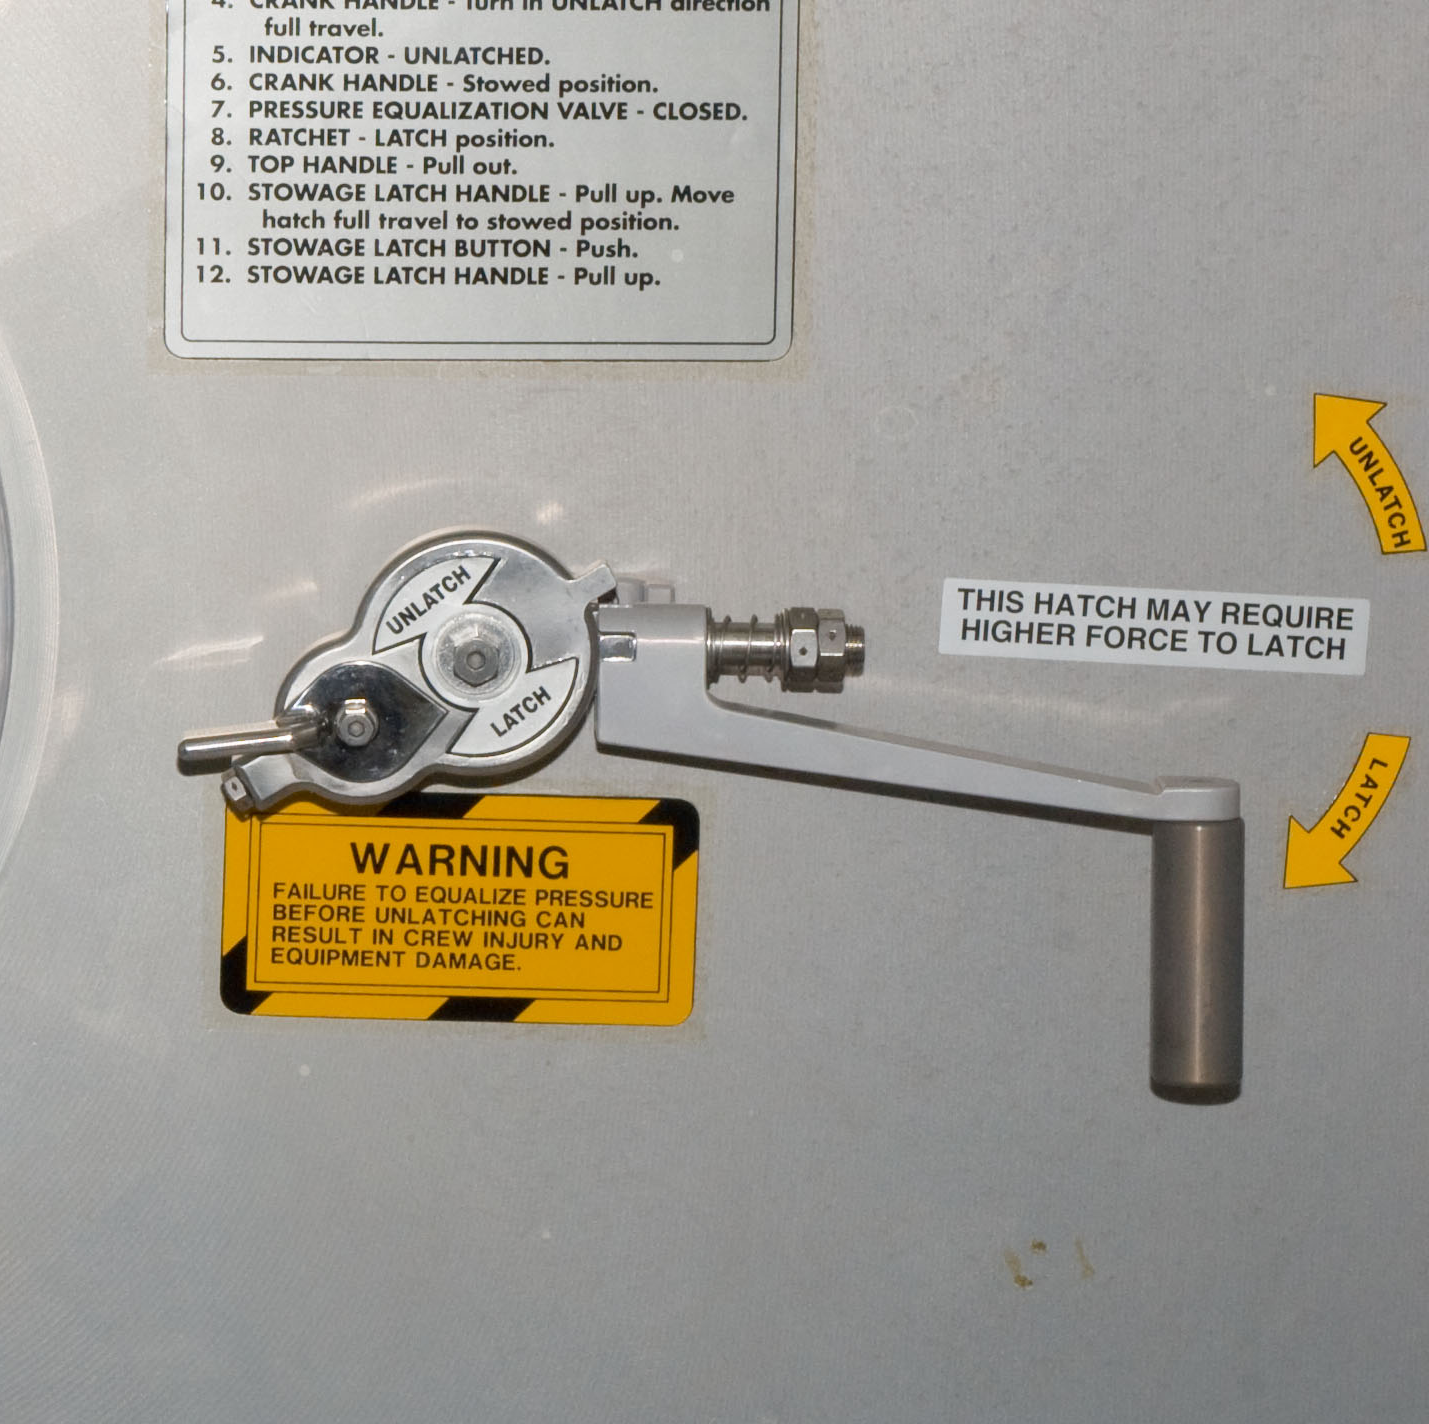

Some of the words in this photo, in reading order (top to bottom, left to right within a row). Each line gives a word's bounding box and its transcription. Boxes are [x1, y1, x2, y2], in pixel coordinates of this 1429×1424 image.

[264, 16, 301, 37] full
[309, 17, 383, 38] travel.
[212, 45, 233, 64] 5.
[250, 44, 379, 65] INDICATOR
[404, 45, 550, 66] UNLATCHED.
[211, 73, 232, 92] 6.
[249, 72, 334, 92] CRANK
[343, 72, 438, 93] HANDLE
[463, 72, 550, 94] Stowed
[558, 72, 659, 99] position.
[212, 100, 232, 119] 7.
[249, 99, 363, 120] PRESSURE
[372, 100, 549, 121] EQUALIZATION
[556, 100, 628, 121] VALVE
[652, 100, 748, 122] CLOSED.
[211, 127, 232, 147] 8.
[249, 126, 351, 147] RATCHET
[375, 128, 447, 149] LATCH
[456, 127, 555, 153] position.
[210, 154, 232, 174] 9.
[248, 154, 295, 175] TOP
[303, 154, 397, 175] HANDLE
[423, 153, 465, 176] Pull
[472, 157, 518, 176] out.
[197, 182, 231, 202] 10.
[248, 182, 366, 203] STOWAGE
[375, 183, 447, 204] LATCH
[455, 183, 550, 204] HANDLE
[575, 182, 617, 204] Pull
[625, 188, 663, 209] up.
[670, 183, 735, 205] Move
[262, 208, 326, 229] hatch
[333, 208, 370, 230] full
[378, 208, 448, 231] travel
[456, 212, 479, 231] to
[487, 210, 572, 232] stowed
[580, 209, 680, 237] position.
[197, 237, 231, 257] 11.
[248, 236, 365, 258] STOWAGE
[374, 238, 446, 259] LATCH
[455, 237, 551, 259] BUTTON
[576, 236, 638, 259] Push.
[197, 264, 231, 284] 12.
[247, 264, 365, 285] STOWAGE
[373, 265, 446, 286] LATCH
[454, 265, 549, 287] HANDLE
[574, 264, 616, 287] Pull
[624, 271, 661, 292] up.
[1349, 436, 1412, 550] UNLATCH
[385, 565, 473, 637] UNLATCH
[957, 587, 1024, 615] THIS
[1034, 591, 1137, 621] HATCH
[1146, 597, 1212, 624] MAY
[1221, 600, 1354, 631] REQUIRE
[961, 617, 1076, 648] HIGHER
[1085, 623, 1188, 653] FORCE
[1197, 629, 1238, 655] TO
[1247, 632, 1346, 662] LATCH
[490, 686, 553, 738] LATCH
[1329, 757, 1388, 840] LATCH
[350, 841, 569, 881] WARNING
[273, 882, 366, 902] FAILURE
[376, 883, 407, 903] TO
[415, 885, 526, 907] EQUALIZE
[535, 888, 653, 910] PRESSURE
[273, 903, 365, 924] BEFORE
[375, 906, 526, 928] UNLATCHING
[536, 910, 585, 930] CAN
[272, 924, 362, 945] RESULT
[372, 927, 394, 946] IN
[403, 928, 473, 948] CREW
[483, 930, 564, 951] INJURY
[575, 932, 623, 952] AND
[271, 946, 406, 968] EQUIPMENT
[416, 951, 522, 972] DAMAGE.
